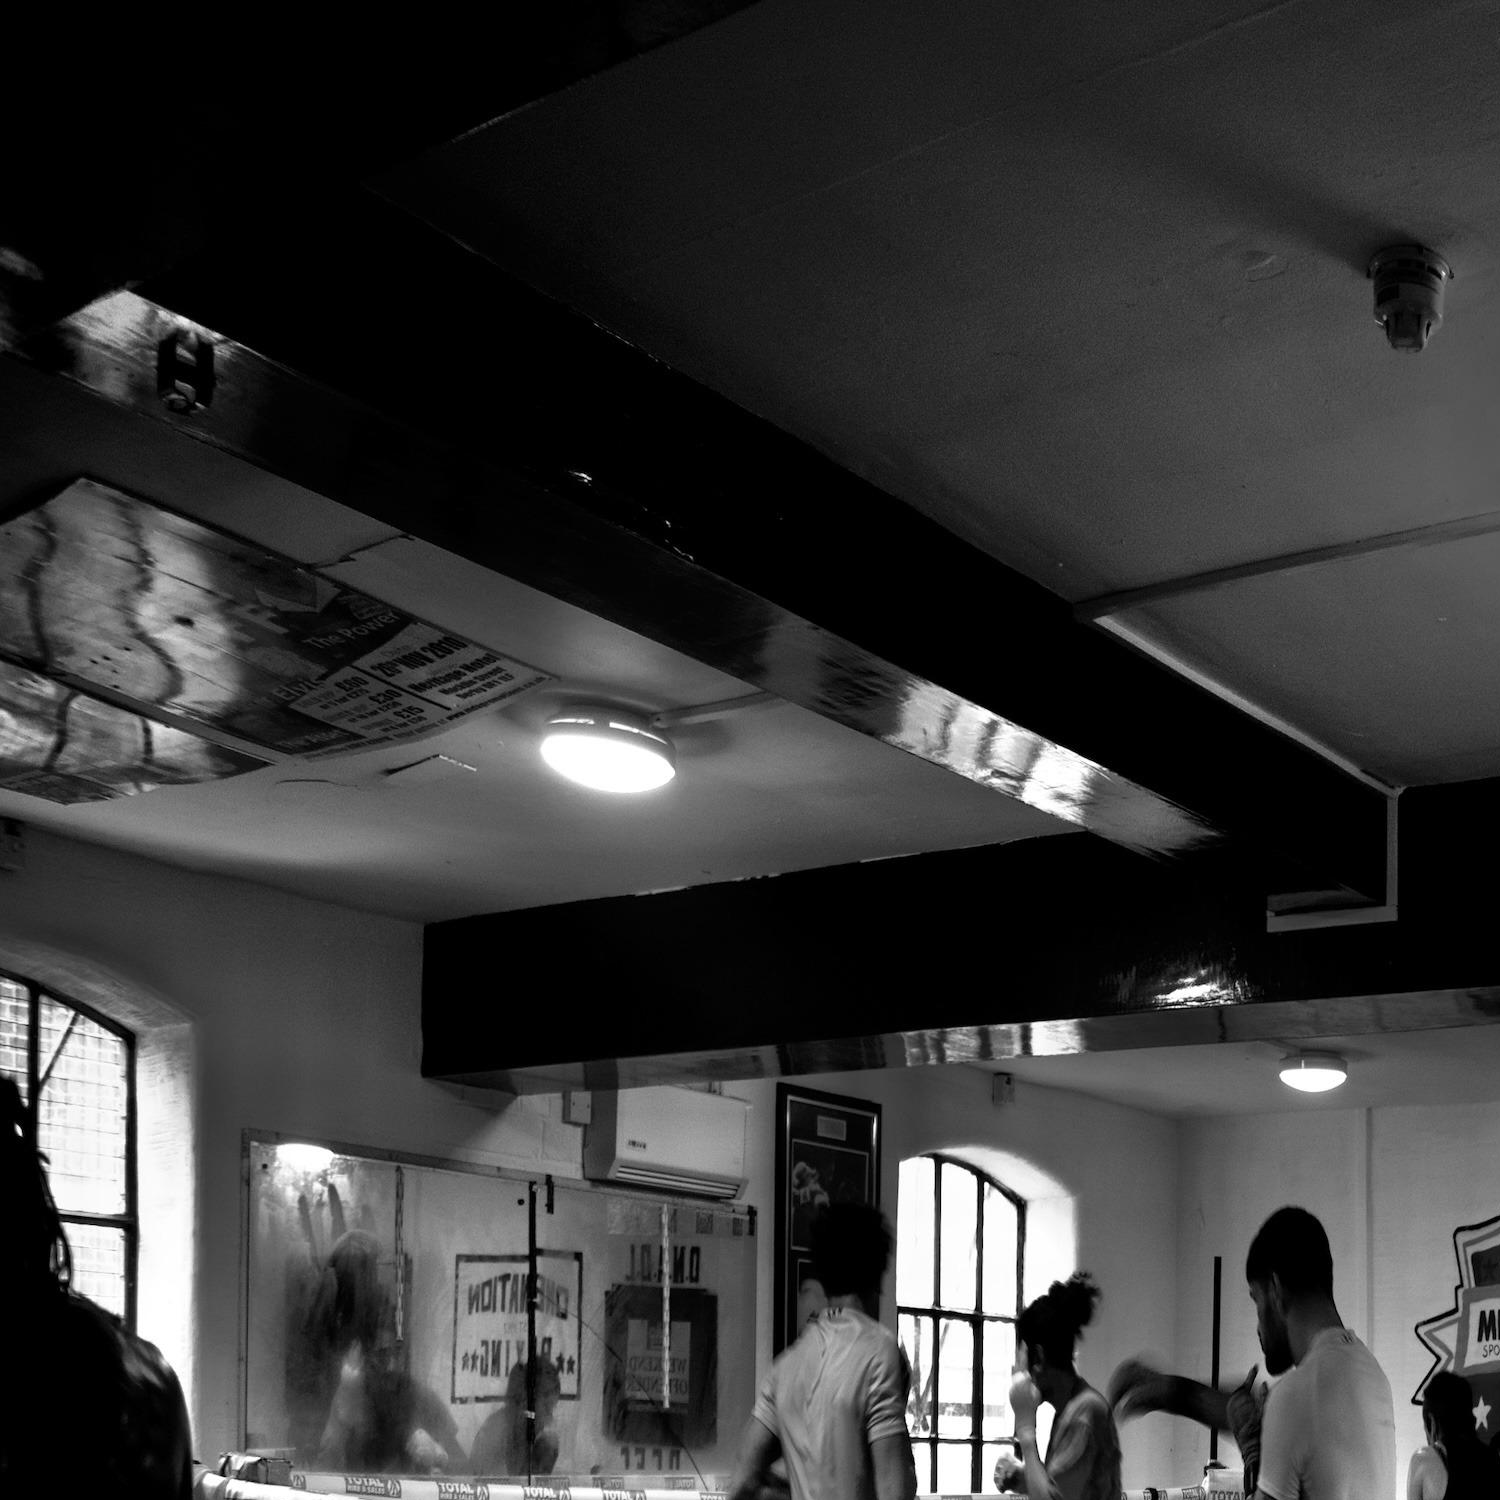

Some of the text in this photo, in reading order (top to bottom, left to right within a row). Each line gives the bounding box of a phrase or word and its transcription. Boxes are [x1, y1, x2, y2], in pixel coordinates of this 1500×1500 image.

[420, 636, 468, 659] 2010
[439, 1483, 474, 1494] TOTAL
[524, 1486, 557, 1498] TOTAL
[603, 1490, 633, 1500] TOTAL
